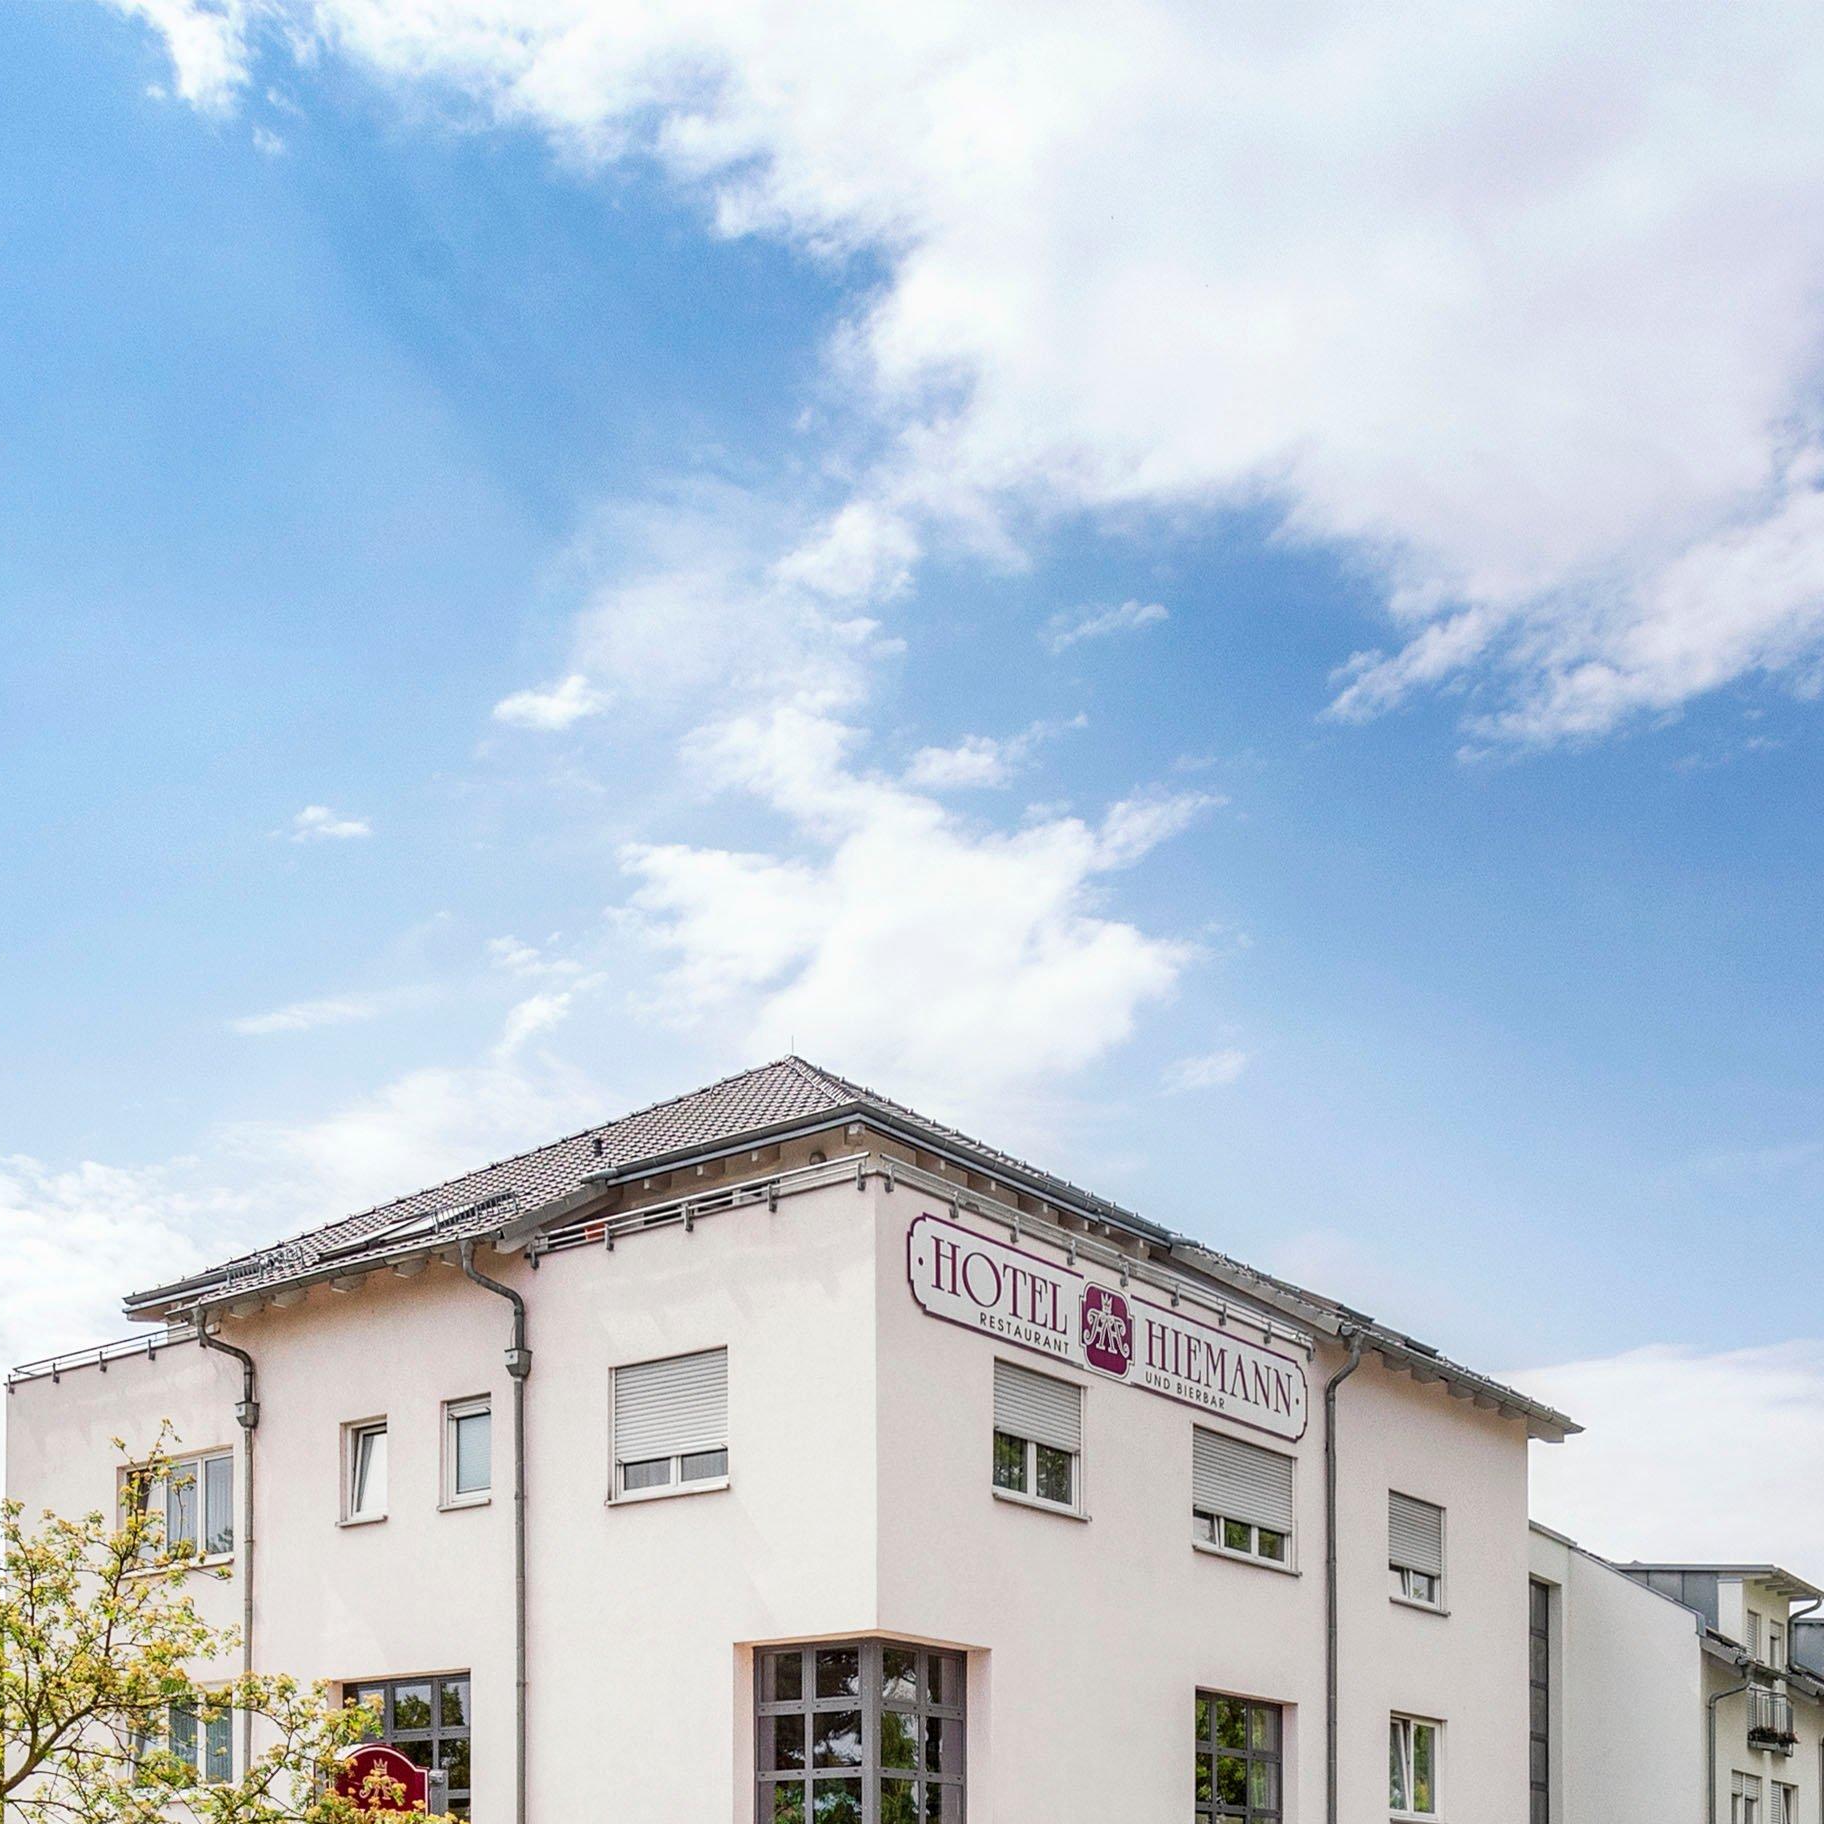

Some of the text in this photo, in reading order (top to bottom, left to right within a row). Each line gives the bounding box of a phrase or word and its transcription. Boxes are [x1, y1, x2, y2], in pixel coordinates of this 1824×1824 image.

[931, 1235, 1068, 1335] HOTEL
[1145, 1319, 1293, 1417] HIEMANN
[980, 1312, 1069, 1355] RESTAURANT
[1145, 1371, 1225, 1410] UND BIERBAR
